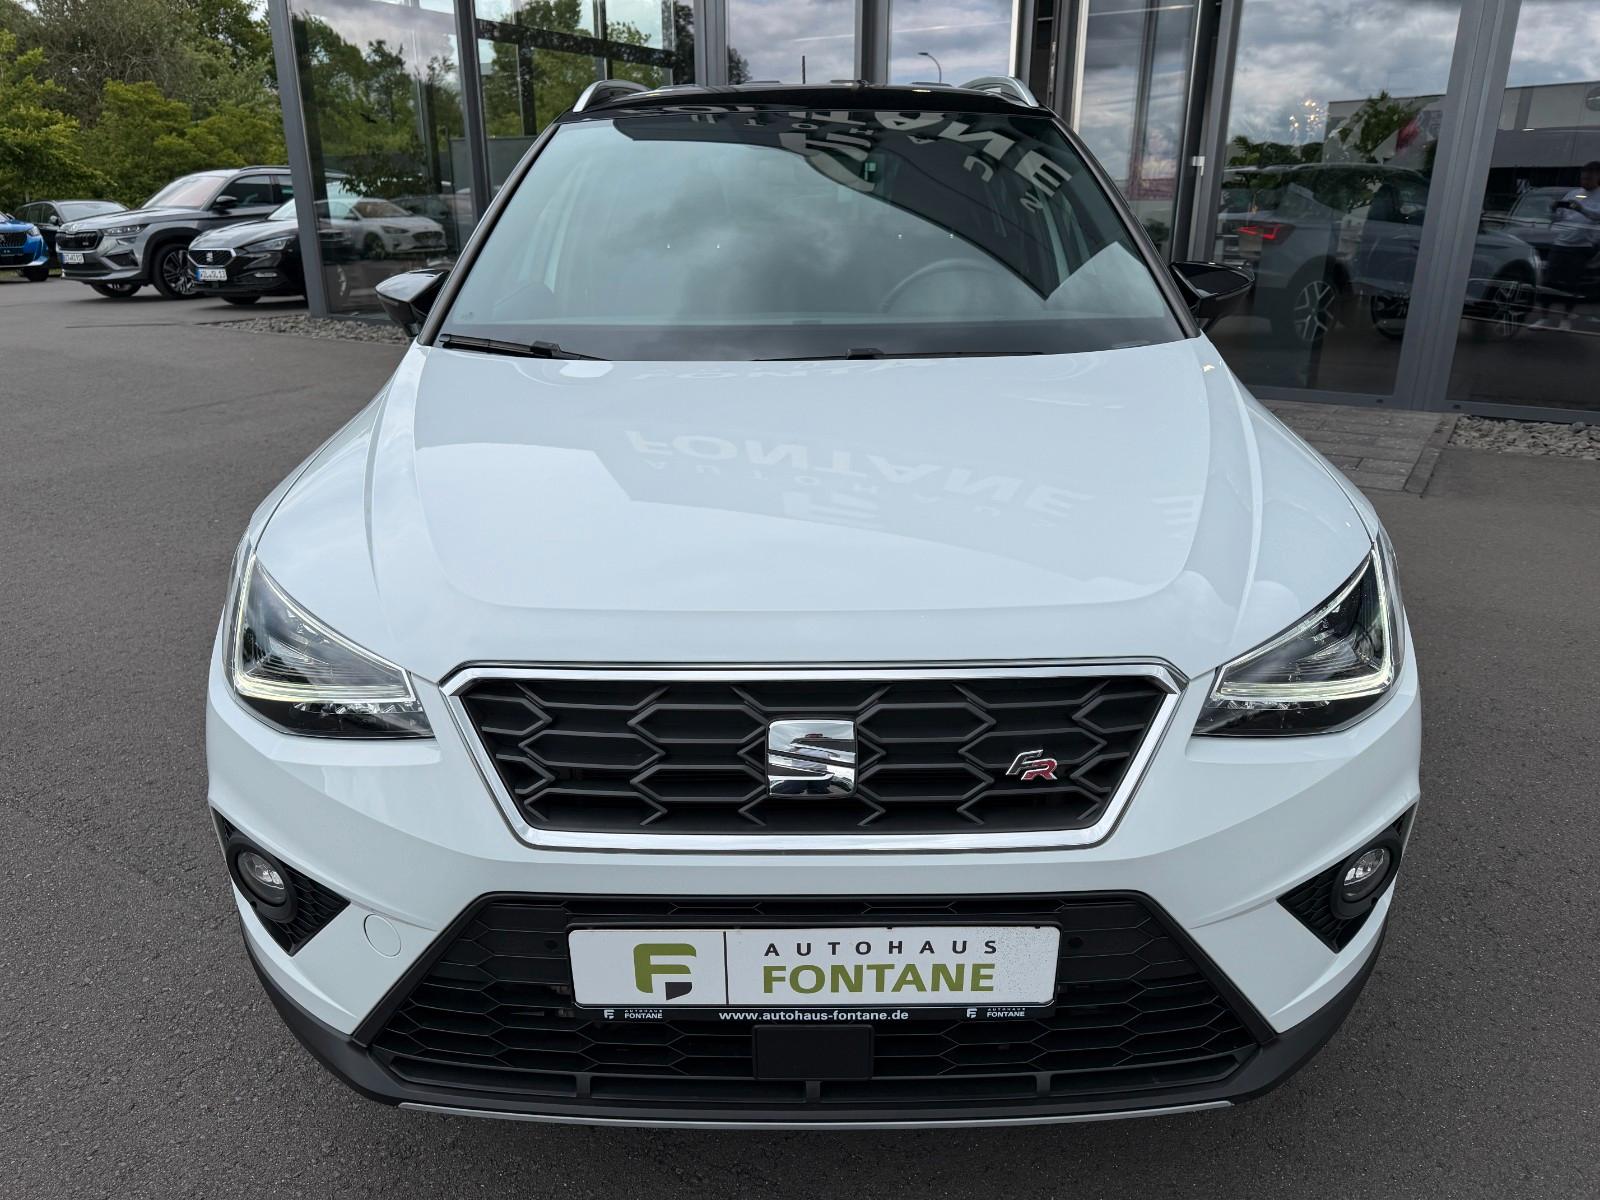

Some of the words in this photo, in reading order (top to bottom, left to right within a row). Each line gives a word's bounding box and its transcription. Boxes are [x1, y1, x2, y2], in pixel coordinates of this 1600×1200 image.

[1005, 749, 1058, 780] FR
[764, 940, 998, 957] AUTOHAUS
[763, 963, 996, 994] FONTANE
[718, 1010, 909, 1021] www.autohaus-fontane.de
